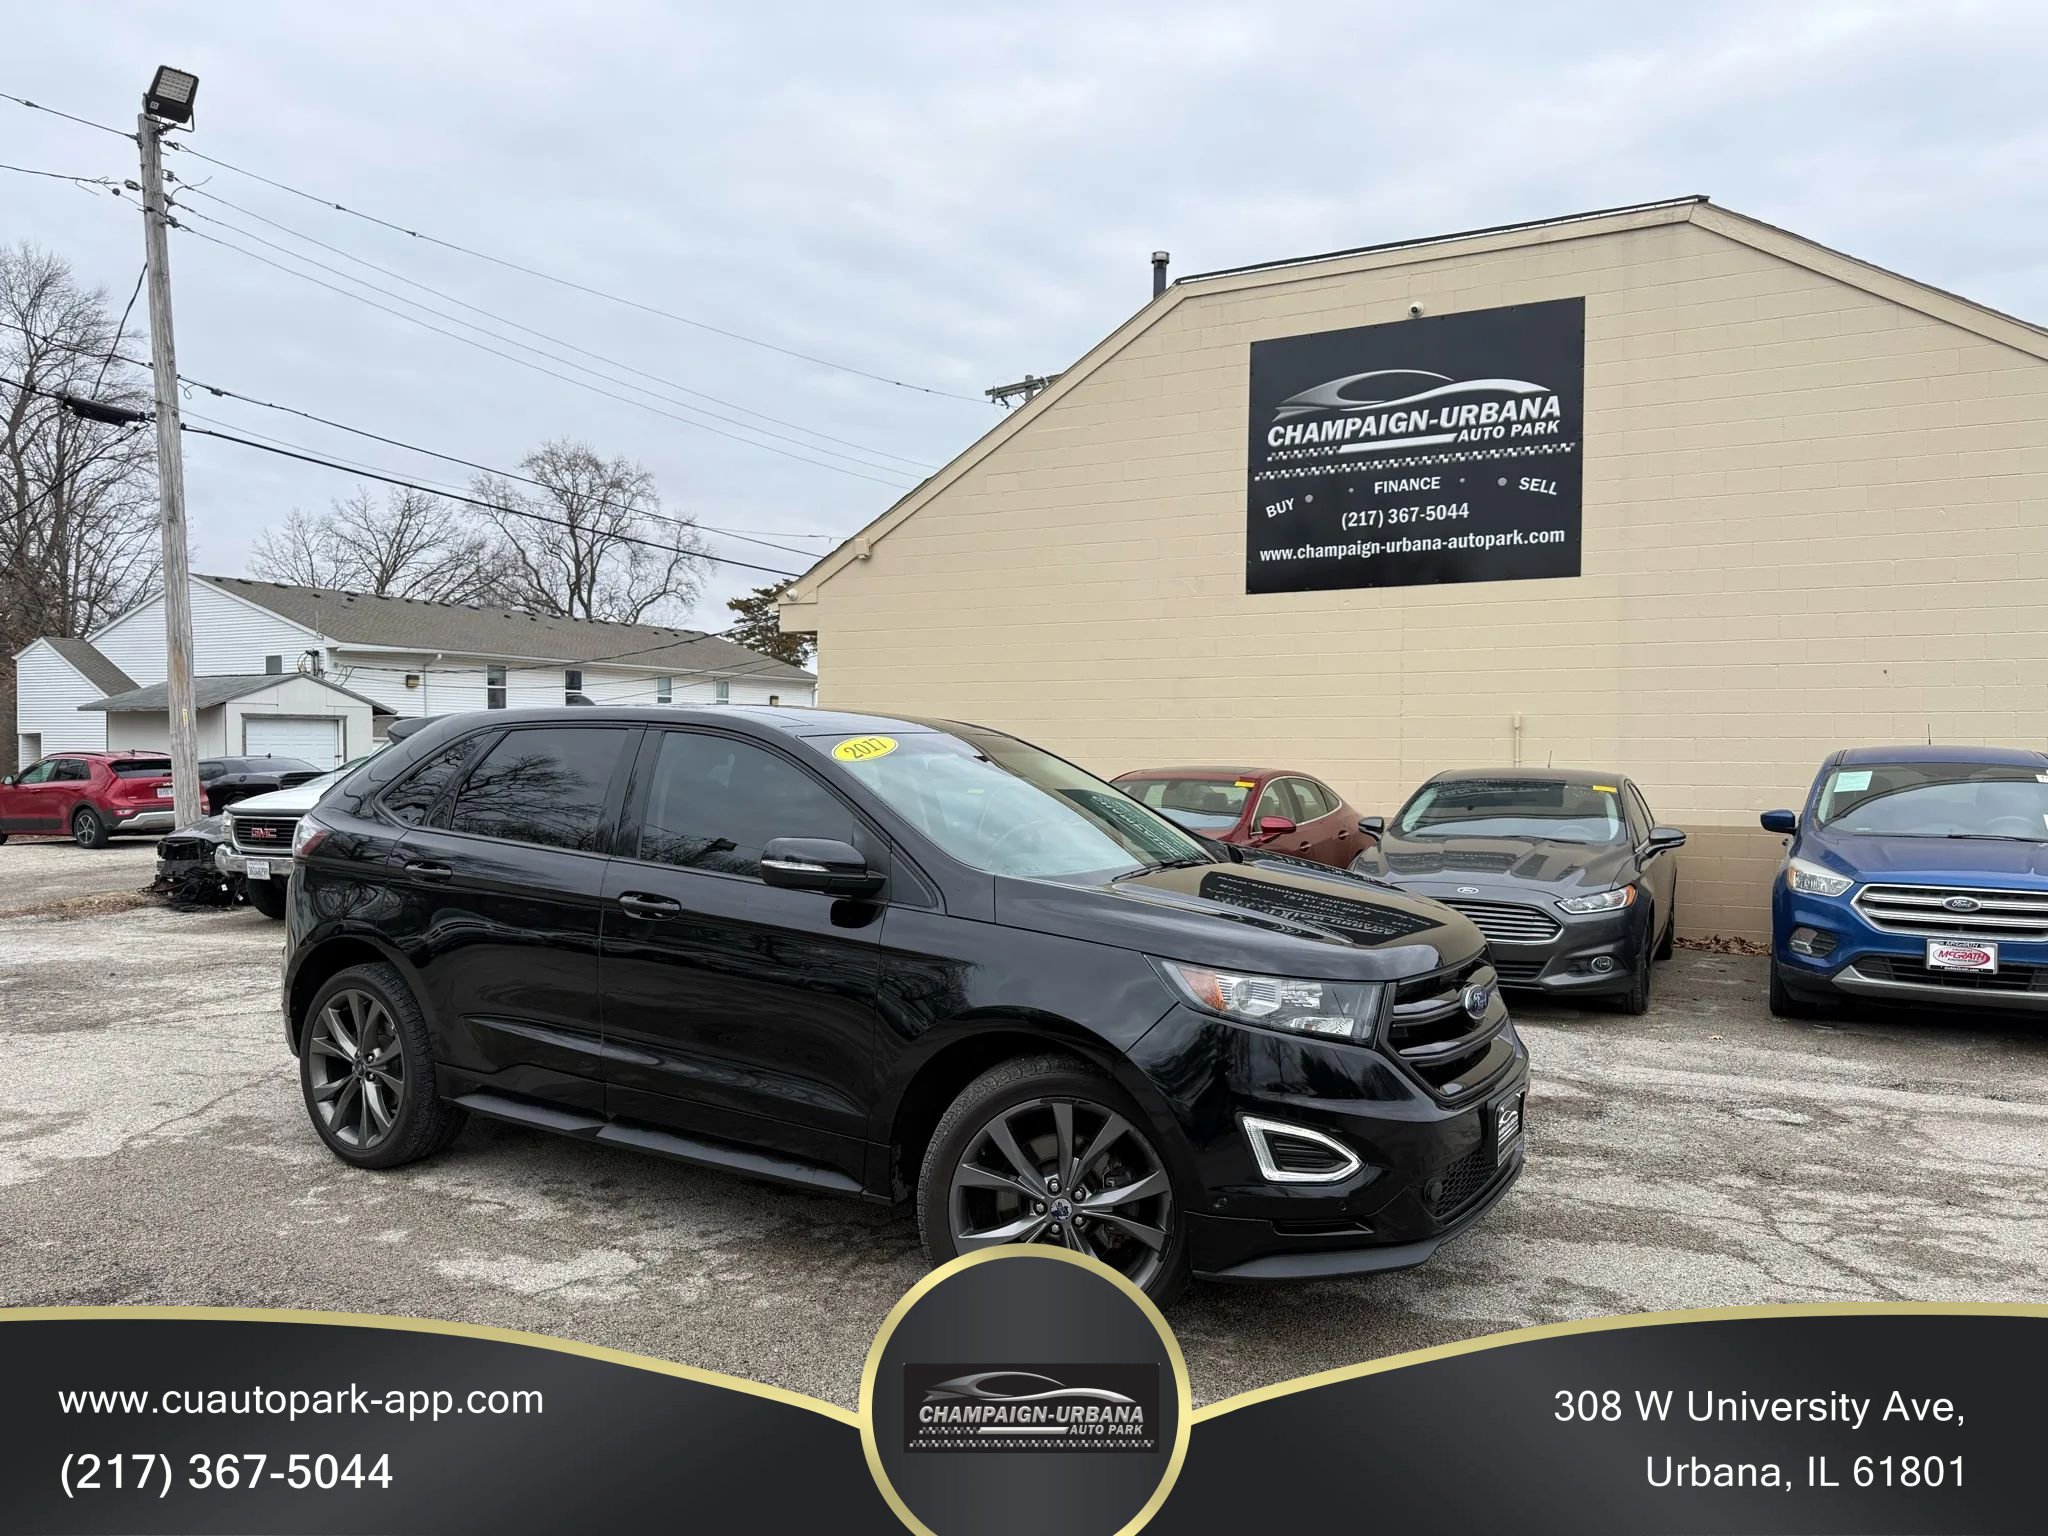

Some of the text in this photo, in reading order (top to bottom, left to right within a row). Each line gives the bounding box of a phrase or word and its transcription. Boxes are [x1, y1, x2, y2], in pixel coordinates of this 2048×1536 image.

[1267, 395, 1561, 448] CHAMPAIGN-URBANA
[1457, 419, 1561, 443] AUTO PARK
[1265, 476, 1558, 518] BUY FINANCE SELL
[1341, 502, 1470, 531] (217) 367-5044
[1259, 529, 1566, 562] www.champaign-urbana-autopark.com
[843, 737, 888, 759] 2017
[251, 827, 277, 839] GMC
[1951, 899, 1973, 908] Ford
